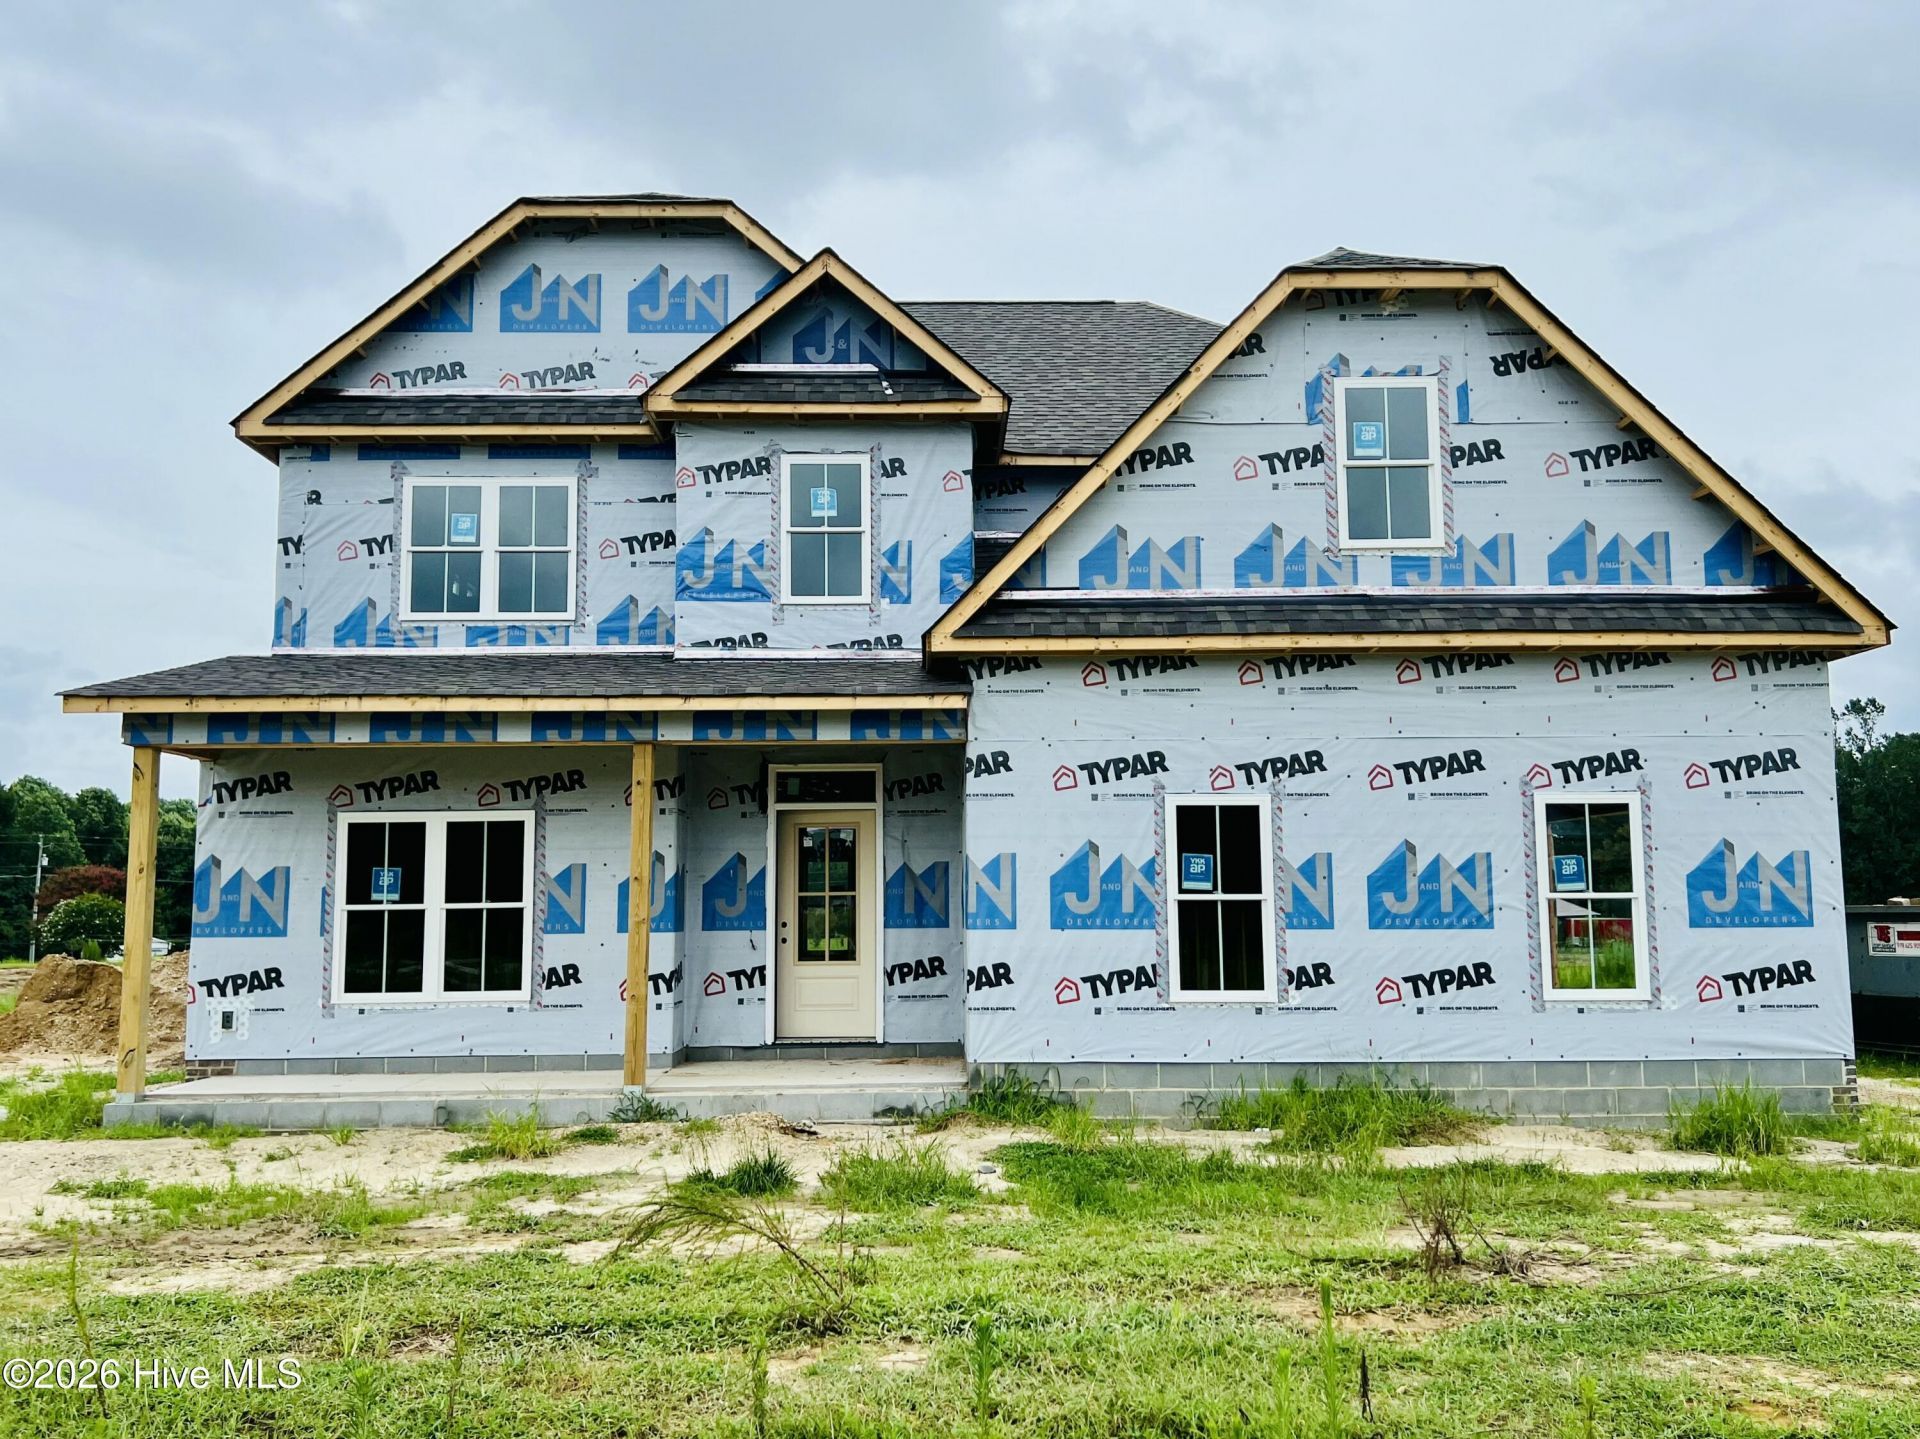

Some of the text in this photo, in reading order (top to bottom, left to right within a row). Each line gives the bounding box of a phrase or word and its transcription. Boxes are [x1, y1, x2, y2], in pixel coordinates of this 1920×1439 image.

[391, 361, 467, 388] TYPAR
[521, 361, 597, 389] TYPAR
[1258, 443, 1325, 475] TYPA
[1450, 438, 1505, 468] PAR
[1569, 437, 1660, 474] TYPAR
[696, 457, 771, 485] TYPAR
[974, 477, 1026, 501] YPAR
[620, 529, 676, 555] TYPA
[1107, 655, 1199, 681] TYPAR
[1264, 654, 1356, 680] TYPAR
[1422, 653, 1515, 678] TYPAR
[1580, 652, 1672, 677] TYPAR
[1736, 651, 1828, 676] TYPAR
[966, 750, 1014, 778] PAR
[1077, 750, 1170, 786] TYPAR
[1234, 750, 1328, 786] TYPAR
[1392, 749, 1486, 785] TYPAR
[1551, 748, 1644, 784] TYPAR
[1709, 747, 1801, 784] TYPAR
[212, 770, 293, 804] TYPAR
[355, 770, 441, 803] TYPAR
[502, 768, 588, 802] TYPAR
[885, 772, 946, 802] YPAR
[221, 894, 239, 902] AND
[1101, 883, 1120, 891] AND
[1419, 883, 1439, 891] AND
[1738, 881, 1758, 889] AND
[1066, 918, 1149, 926] DEVELOPER
[1385, 918, 1478, 926] DEVELOPERS
[1705, 915, 1798, 924] DEVELOPERS
[197, 966, 285, 998] TYPAR
[726, 965, 766, 992] TYP
[885, 955, 948, 987] YPAR
[967, 962, 1015, 993] PAR
[1080, 963, 1157, 999] TYPA
[1287, 962, 1335, 991] PAR
[1401, 961, 1496, 999] TYPAR
[1721, 959, 1816, 997] TYPAR
